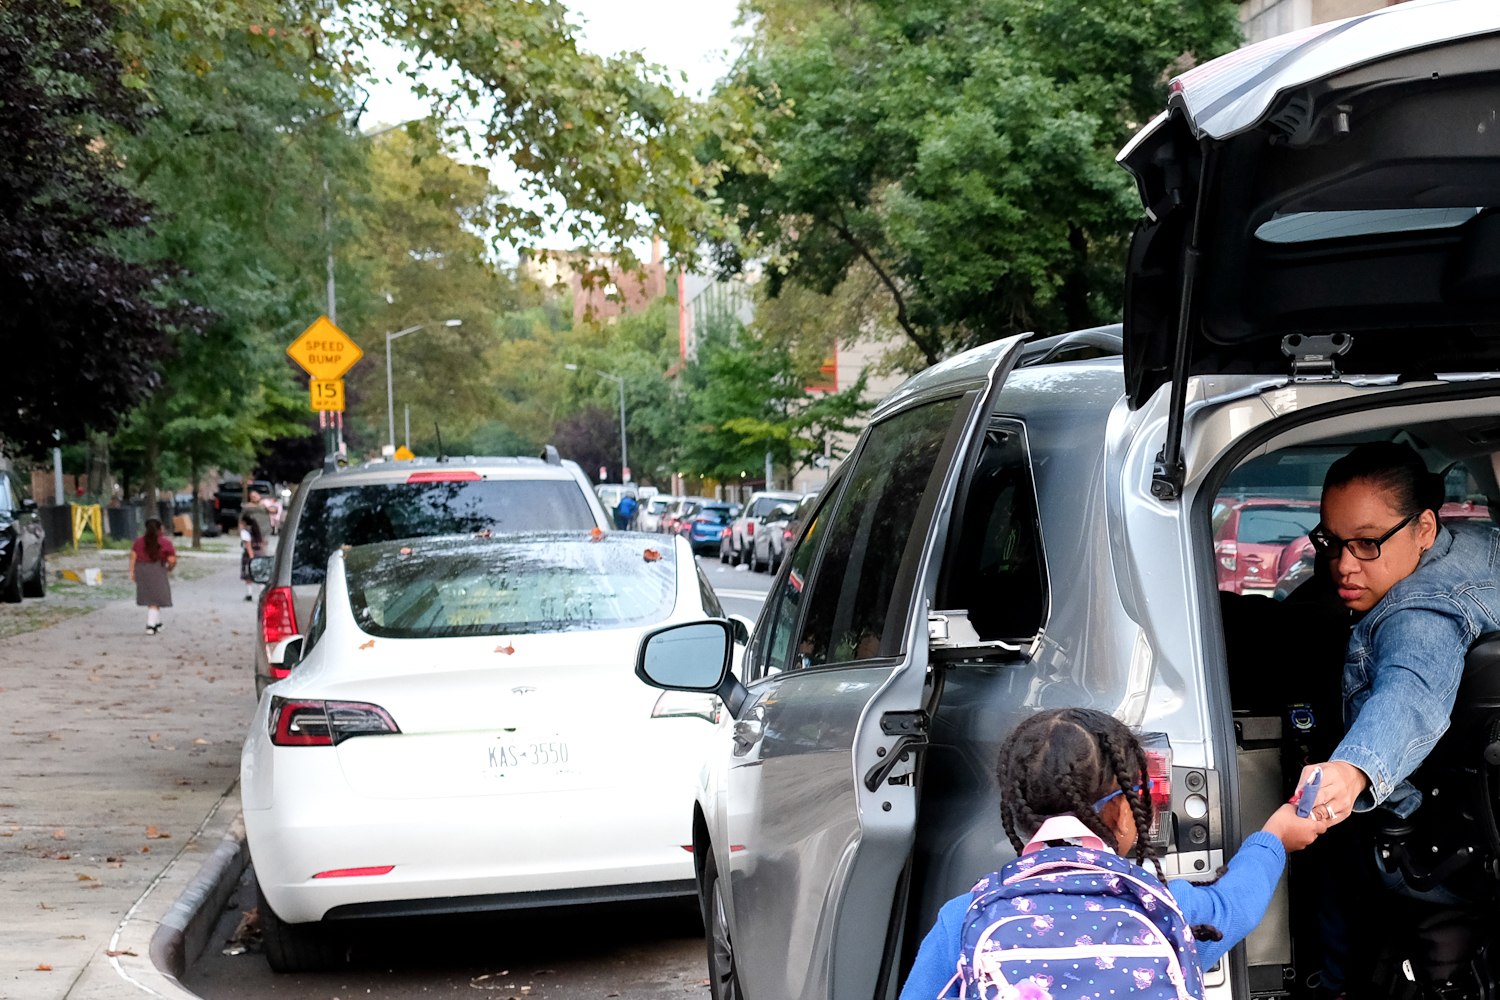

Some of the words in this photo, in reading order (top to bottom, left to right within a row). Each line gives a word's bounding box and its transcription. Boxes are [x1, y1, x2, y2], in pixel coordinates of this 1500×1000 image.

[305, 341, 344, 352] SPEED
[308, 354, 342, 364] BUMP
[317, 383, 337, 398] 15
